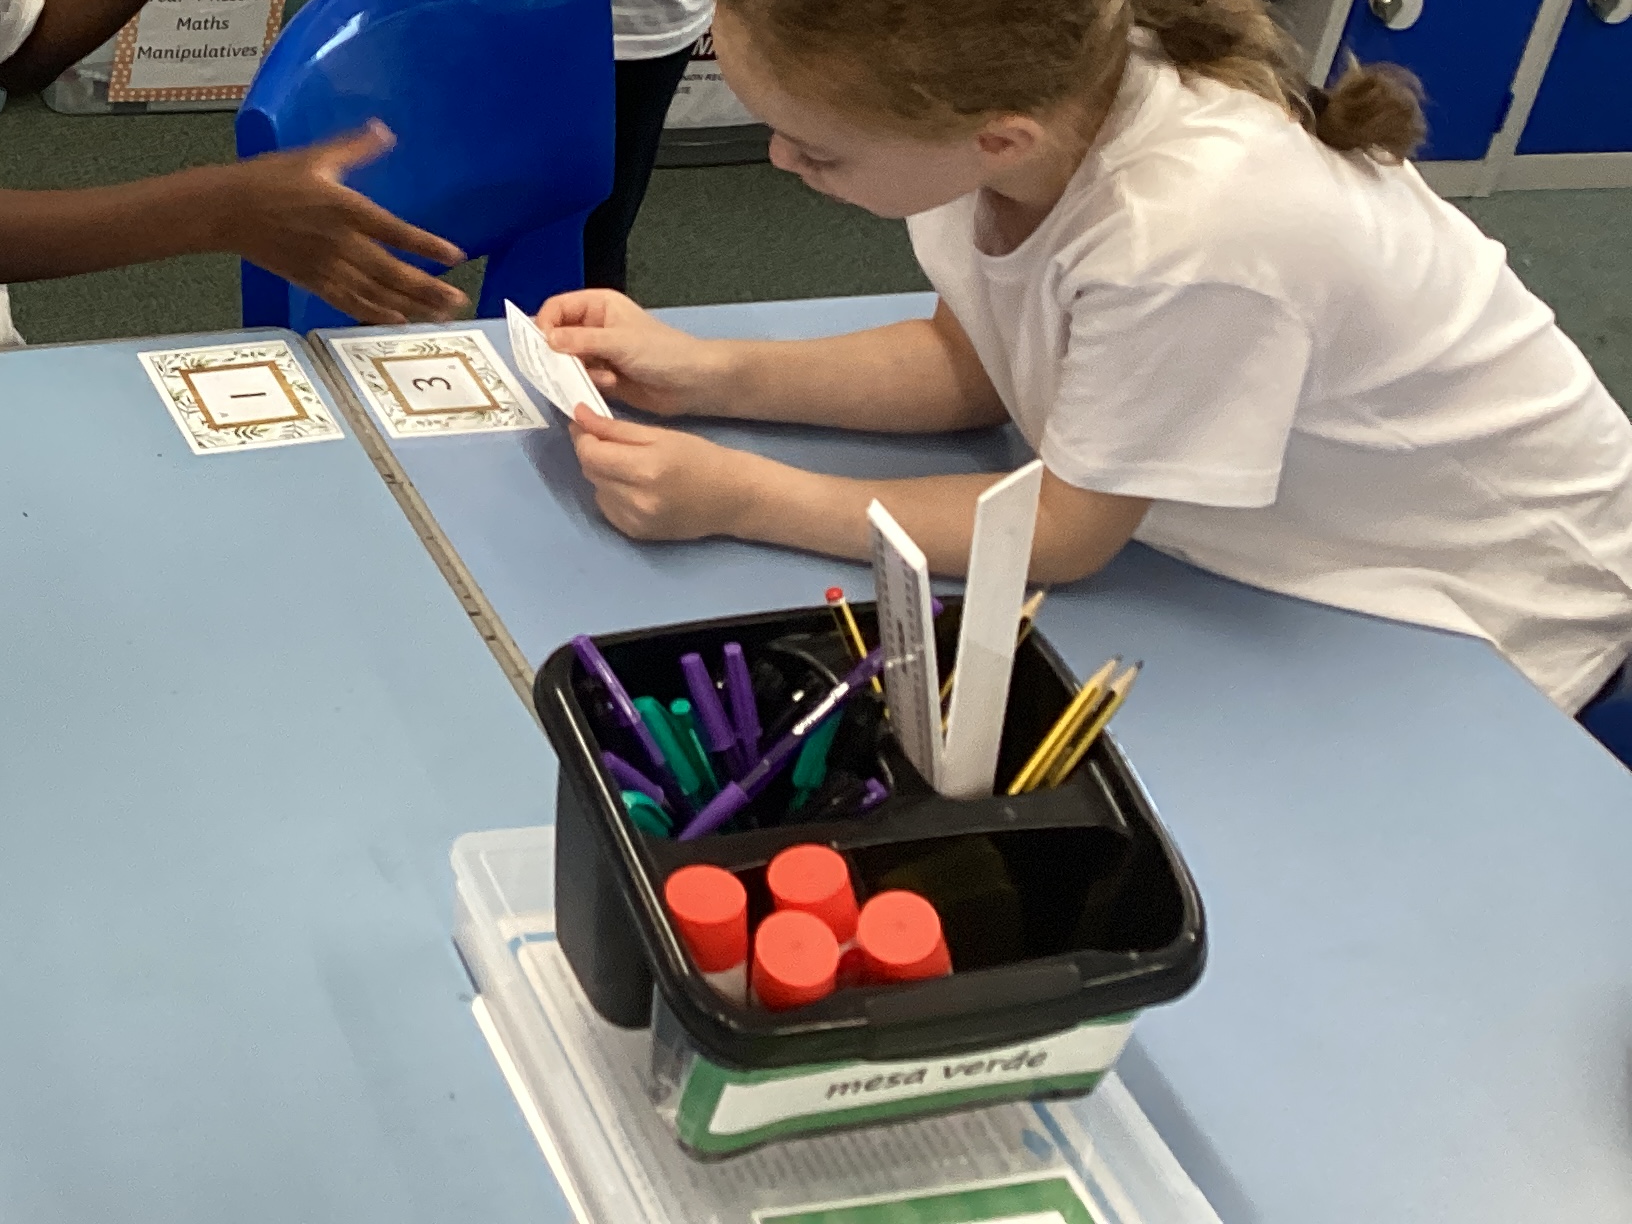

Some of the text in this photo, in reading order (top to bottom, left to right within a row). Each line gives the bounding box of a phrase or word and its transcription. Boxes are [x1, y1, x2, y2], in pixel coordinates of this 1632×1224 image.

[175, 16, 230, 31] Maths
[137, 45, 258, 63] Manipulatives
[413, 375, 452, 392] 3
[825, 1049, 1048, 1101] mesa verde
